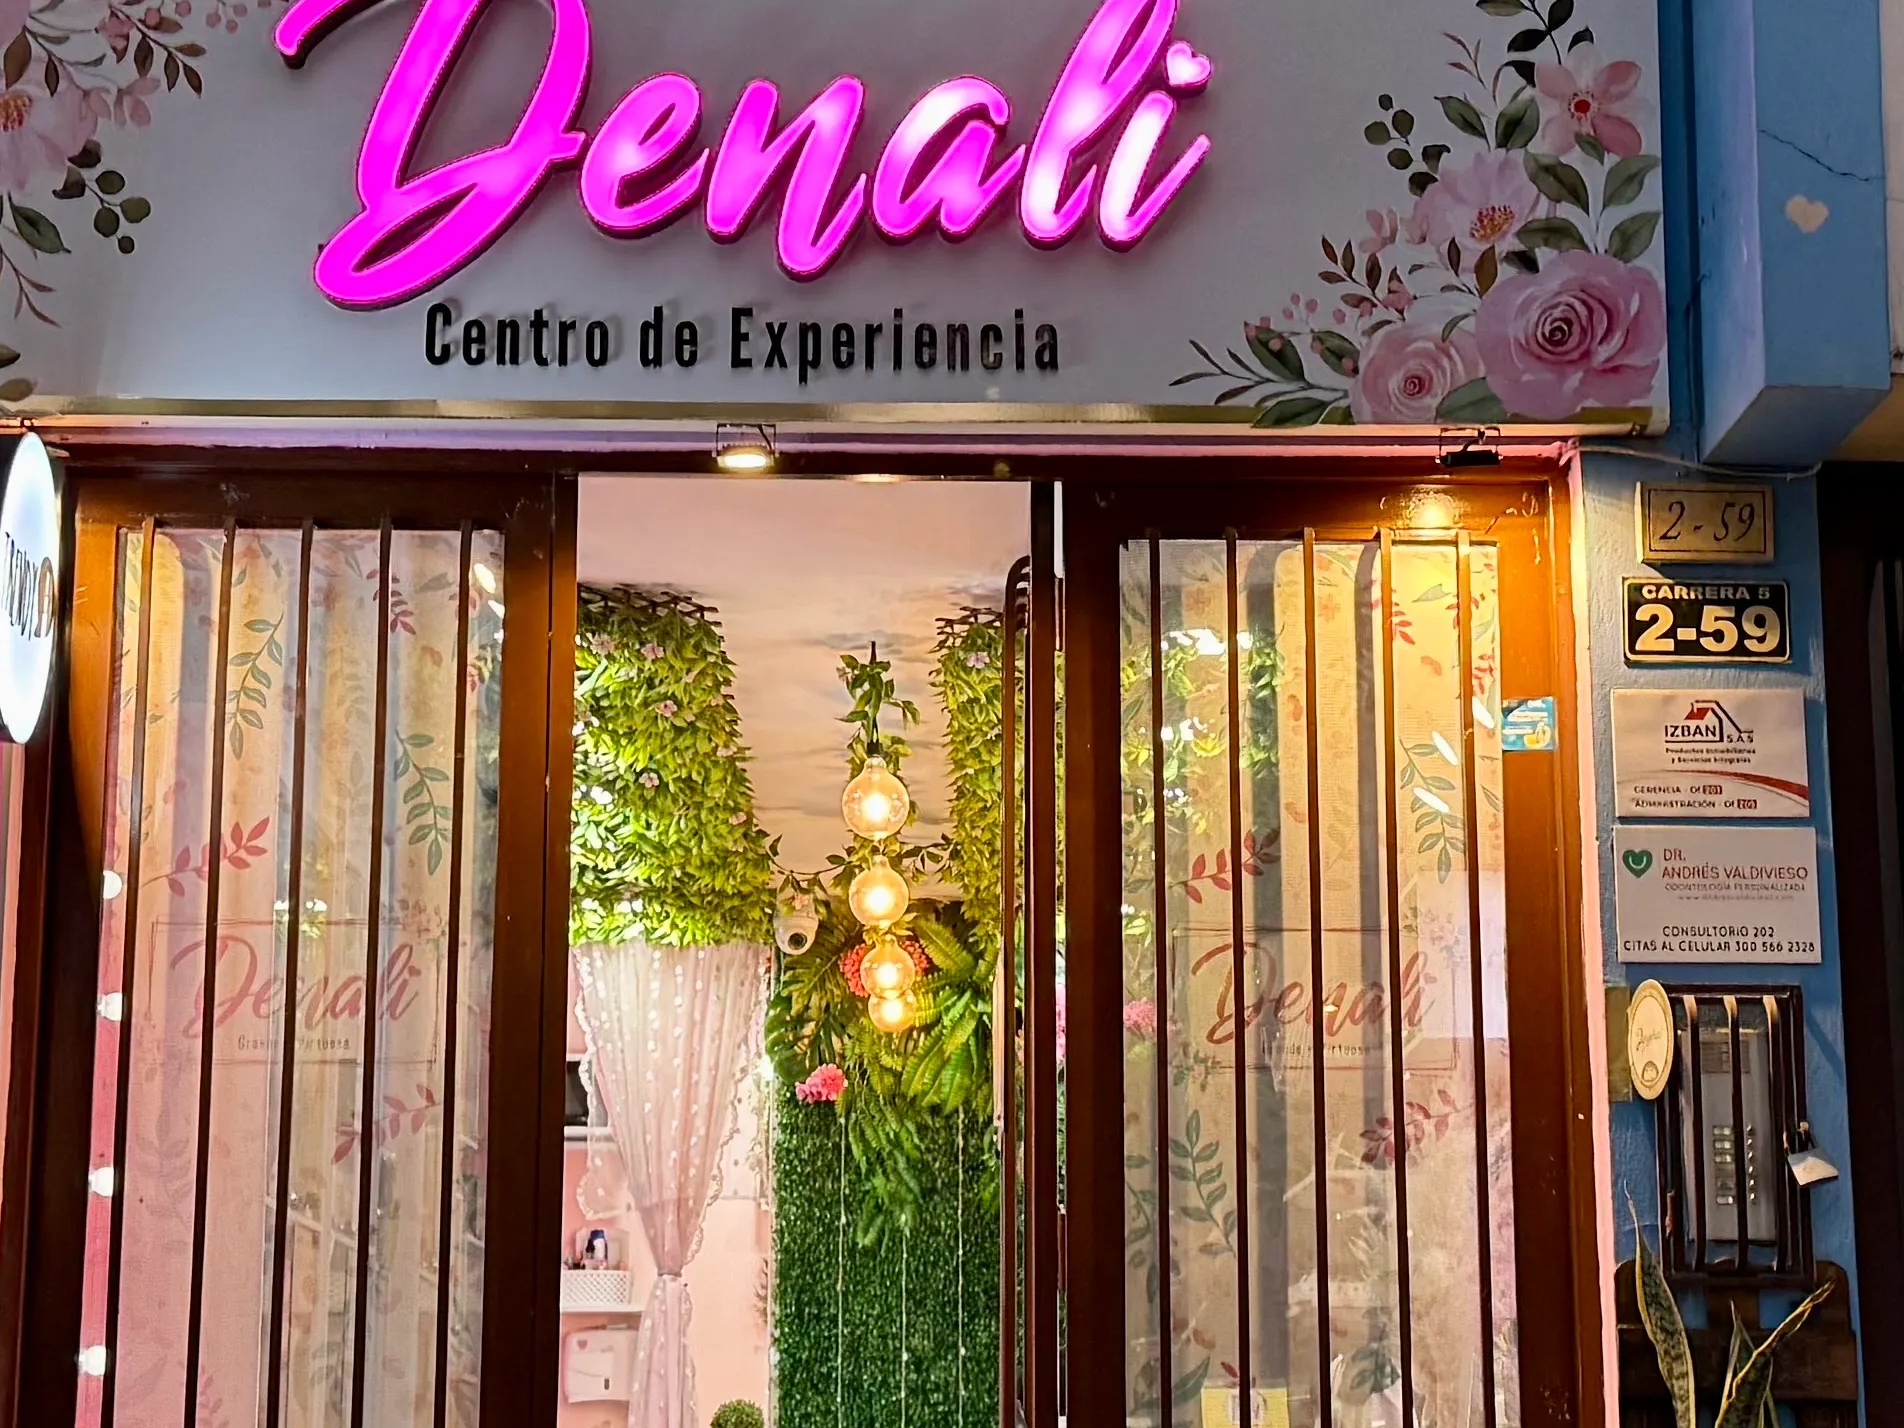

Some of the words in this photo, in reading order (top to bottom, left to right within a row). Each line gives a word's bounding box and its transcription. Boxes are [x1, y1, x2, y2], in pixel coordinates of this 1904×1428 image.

[425, 303, 609, 369] Centro
[638, 304, 698, 372] de
[730, 306, 1059, 386] Experiencia
[1641, 584, 1748, 601] CARRERA
[1633, 604, 1782, 654] 2-59
[1664, 724, 1717, 738] IZBAN
[1634, 785, 1682, 795] GERENCIA
[1634, 798, 1716, 808] ADMINISTRACIÓN
[1663, 848, 1686, 862] DR.
[1662, 862, 1720, 880] ANDRÉS
[1723, 866, 1809, 881] VALDIVIESO
[1662, 925, 1749, 938] CONSULTORIO
[1753, 926, 1775, 938] 202
[1623, 940, 1657, 952] CITAS
[1661, 941, 1675, 952] AL
[1678, 941, 1731, 952] CELULAR
[1735, 941, 1757, 952] 300
[170, 934, 422, 1040] Denali
